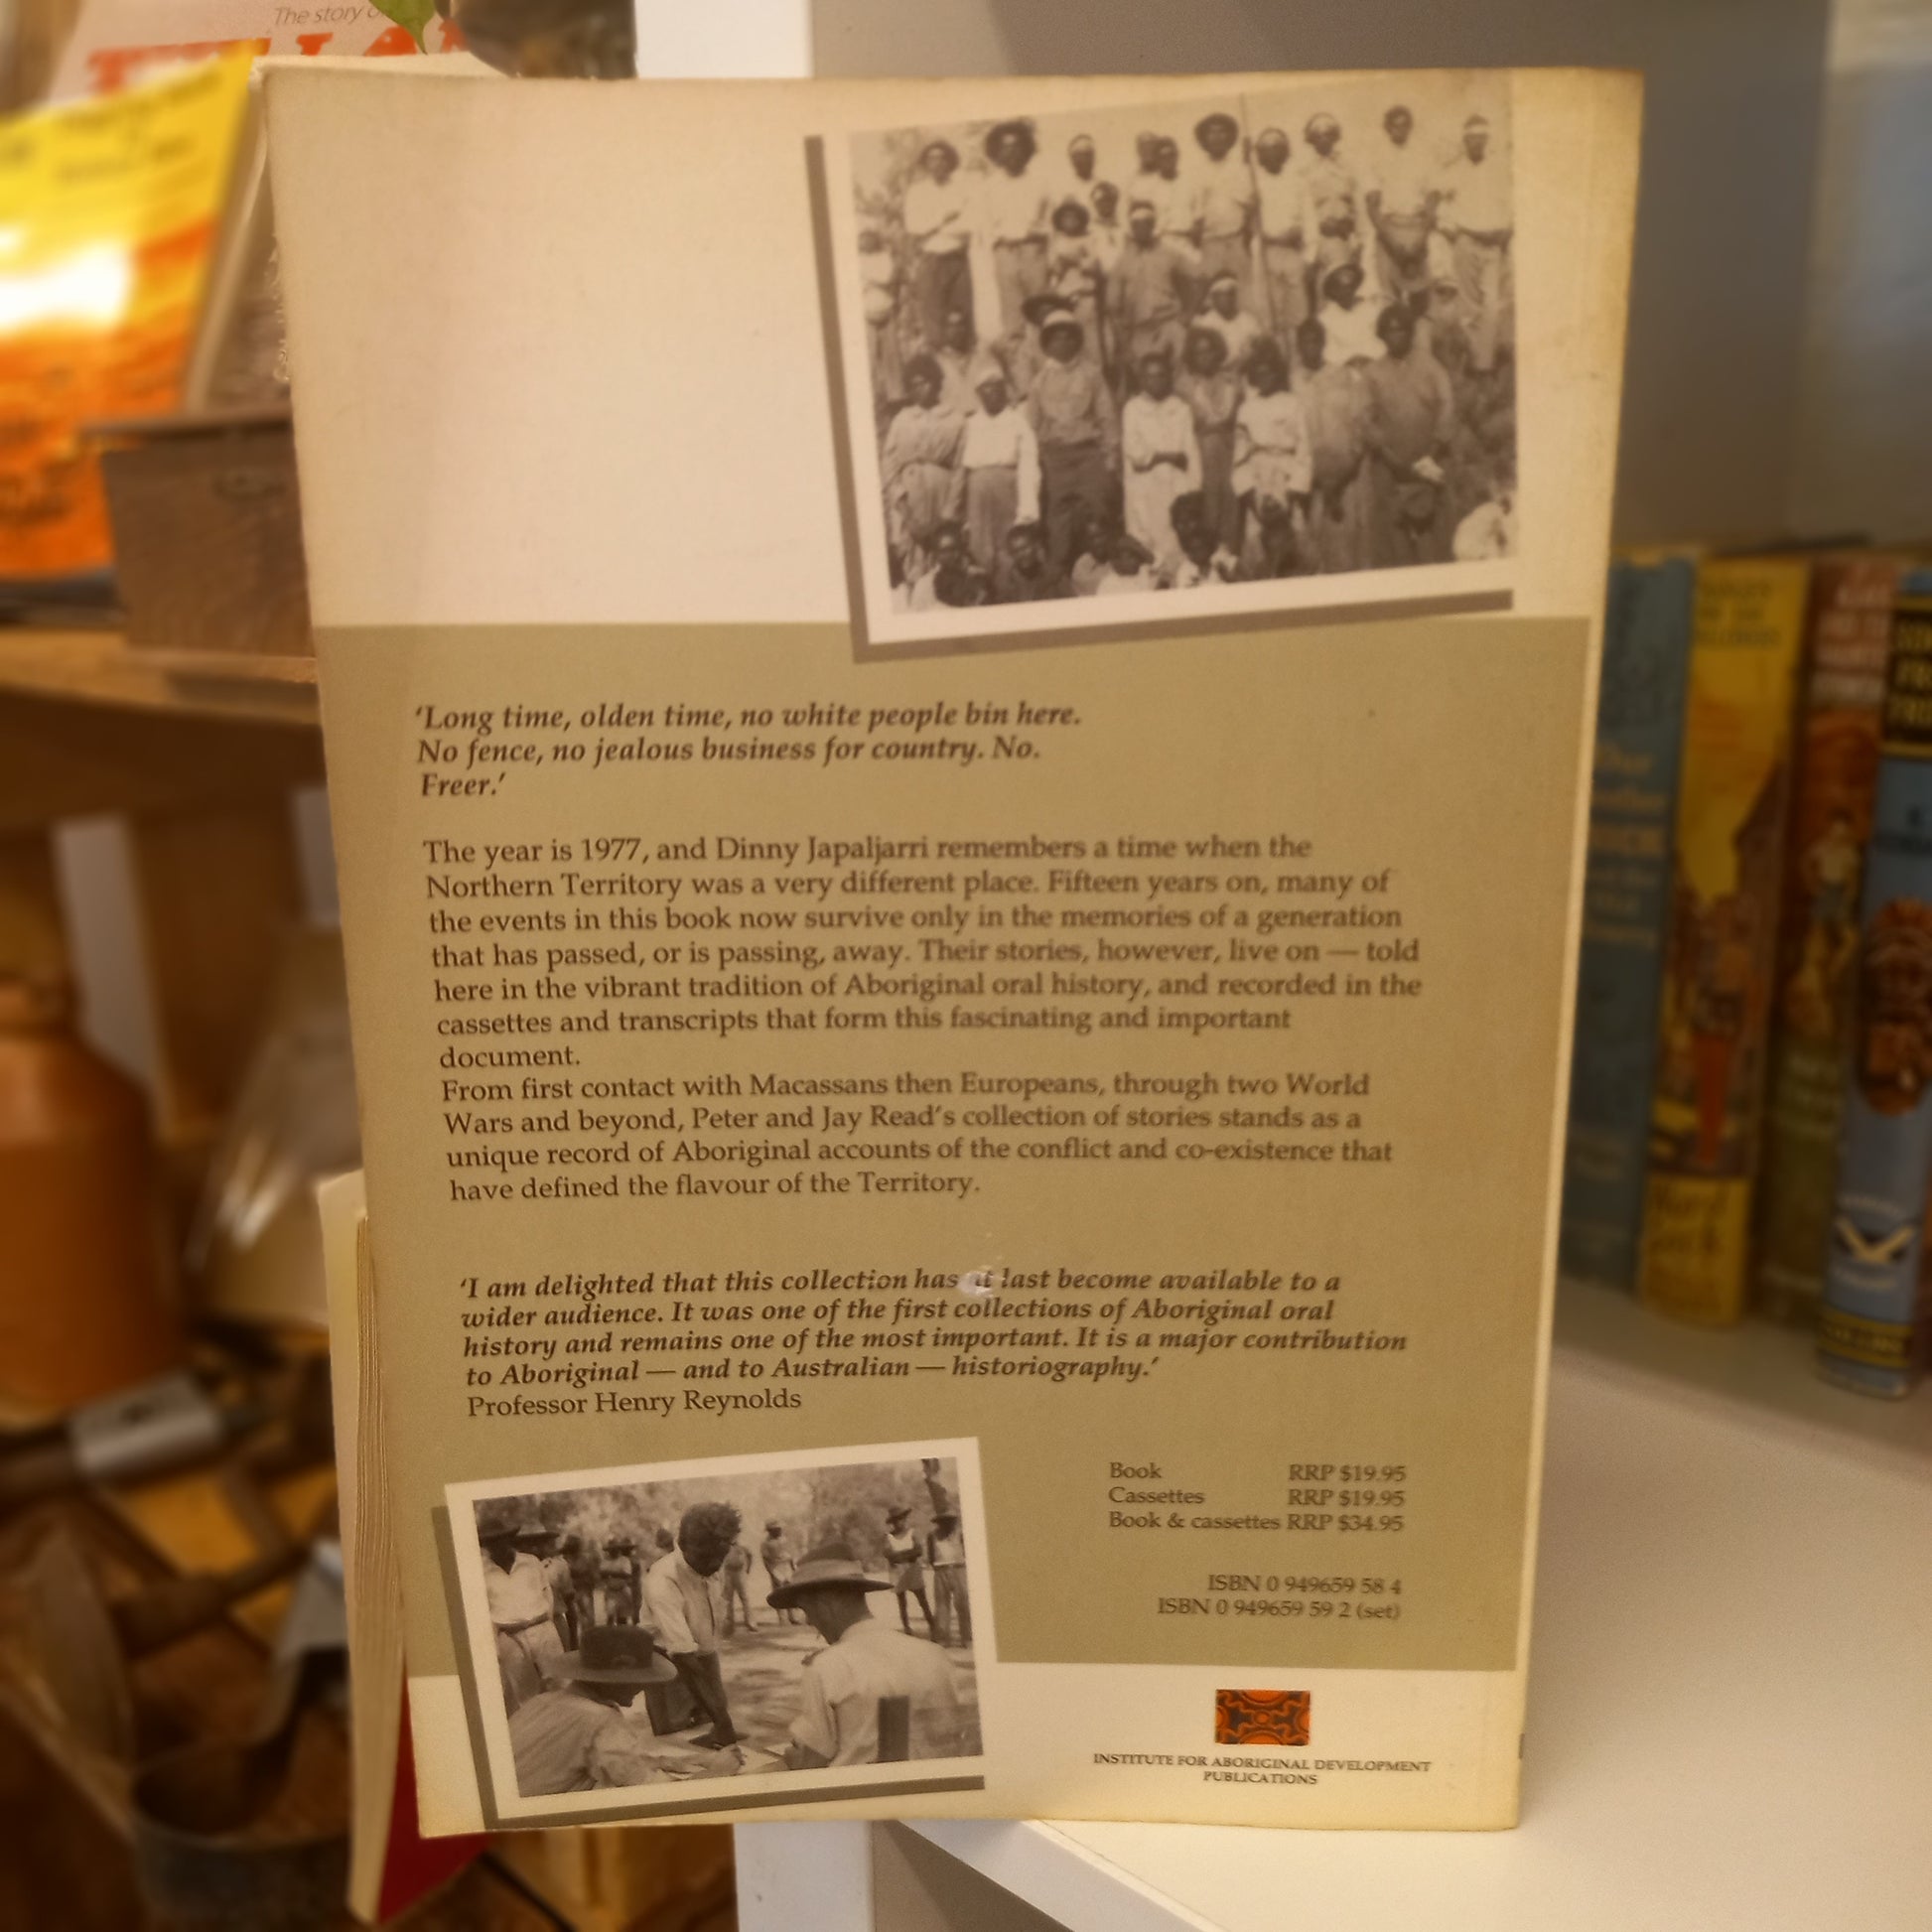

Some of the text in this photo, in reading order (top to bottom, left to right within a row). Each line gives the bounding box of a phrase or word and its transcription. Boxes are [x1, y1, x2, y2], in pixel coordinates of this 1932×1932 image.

[275, 7, 310, 25] The
[315, 5, 363, 24] story
[503, 704, 571, 732] time,
[581, 702, 653, 728] olden
[665, 703, 731, 731] time,
[741, 710, 773, 727] no
[782, 701, 861, 727] white
[868, 700, 957, 734] people
[966, 700, 1008, 725] bin
[1017, 700, 1080, 726] here.
[418, 735, 1038, 770] No fence, no jealous business for country. No.
[423, 834, 1311, 871] The year is 1977, and Dinny Japaljarri remembers a time when the
[427, 868, 1390, 903] Northern Territory was a very different place. Fifteen years on, many of
[430, 903, 1401, 934] the events in this book now survive only in the memories of a generation
[438, 1006, 1290, 1038] cassettes and transcripts that form this fascinating and important
[440, 1046, 580, 1069] document.
[442, 1071, 1369, 1102] From first contact with Macassans then Europeans, through two World
[447, 1137, 1391, 1174] unique record of Aboriginal accounts of the conflict and co-existence that
[450, 1172, 979, 1201] have defined the flavour of the Territory.
[487, 1281, 526, 1299] am
[535, 1271, 654, 1302] delighted
[663, 1271, 718, 1293] that
[726, 1270, 773, 1293] this
[780, 1268, 909, 1293] collection
[913, 1268, 959, 1291] has
[1001, 1267, 1051, 1290] last
[1058, 1268, 1152, 1290] become
[1160, 1268, 1282, 1291] available
[1291, 1272, 1316, 1292] to
[1324, 1276, 1339, 1292] a
[461, 1297, 1334, 1328] wider audience. It was one of the first collections of Aboriginal oral
[468, 1387, 801, 1418] Professor Henry Reynolds
[1110, 1462, 1162, 1479] Book
[1289, 1463, 1406, 1482] RRP $19.95
[1109, 1485, 1205, 1504] Cassettes
[1288, 1488, 1407, 1510] RRP $19.95
[1110, 1510, 1404, 1533] Book & cassettes RRP $34.95
[1207, 1574, 1401, 1595] ISBN 0 949659 58 4
[1158, 1597, 1401, 1620] ISBN 0 949659 59 2 (set)
[1094, 1753, 1432, 1772] INSTITUTE FOR ABORIGINAL DEVELOPMENT
[1203, 1770, 1317, 1785] PUBLICATIONS
